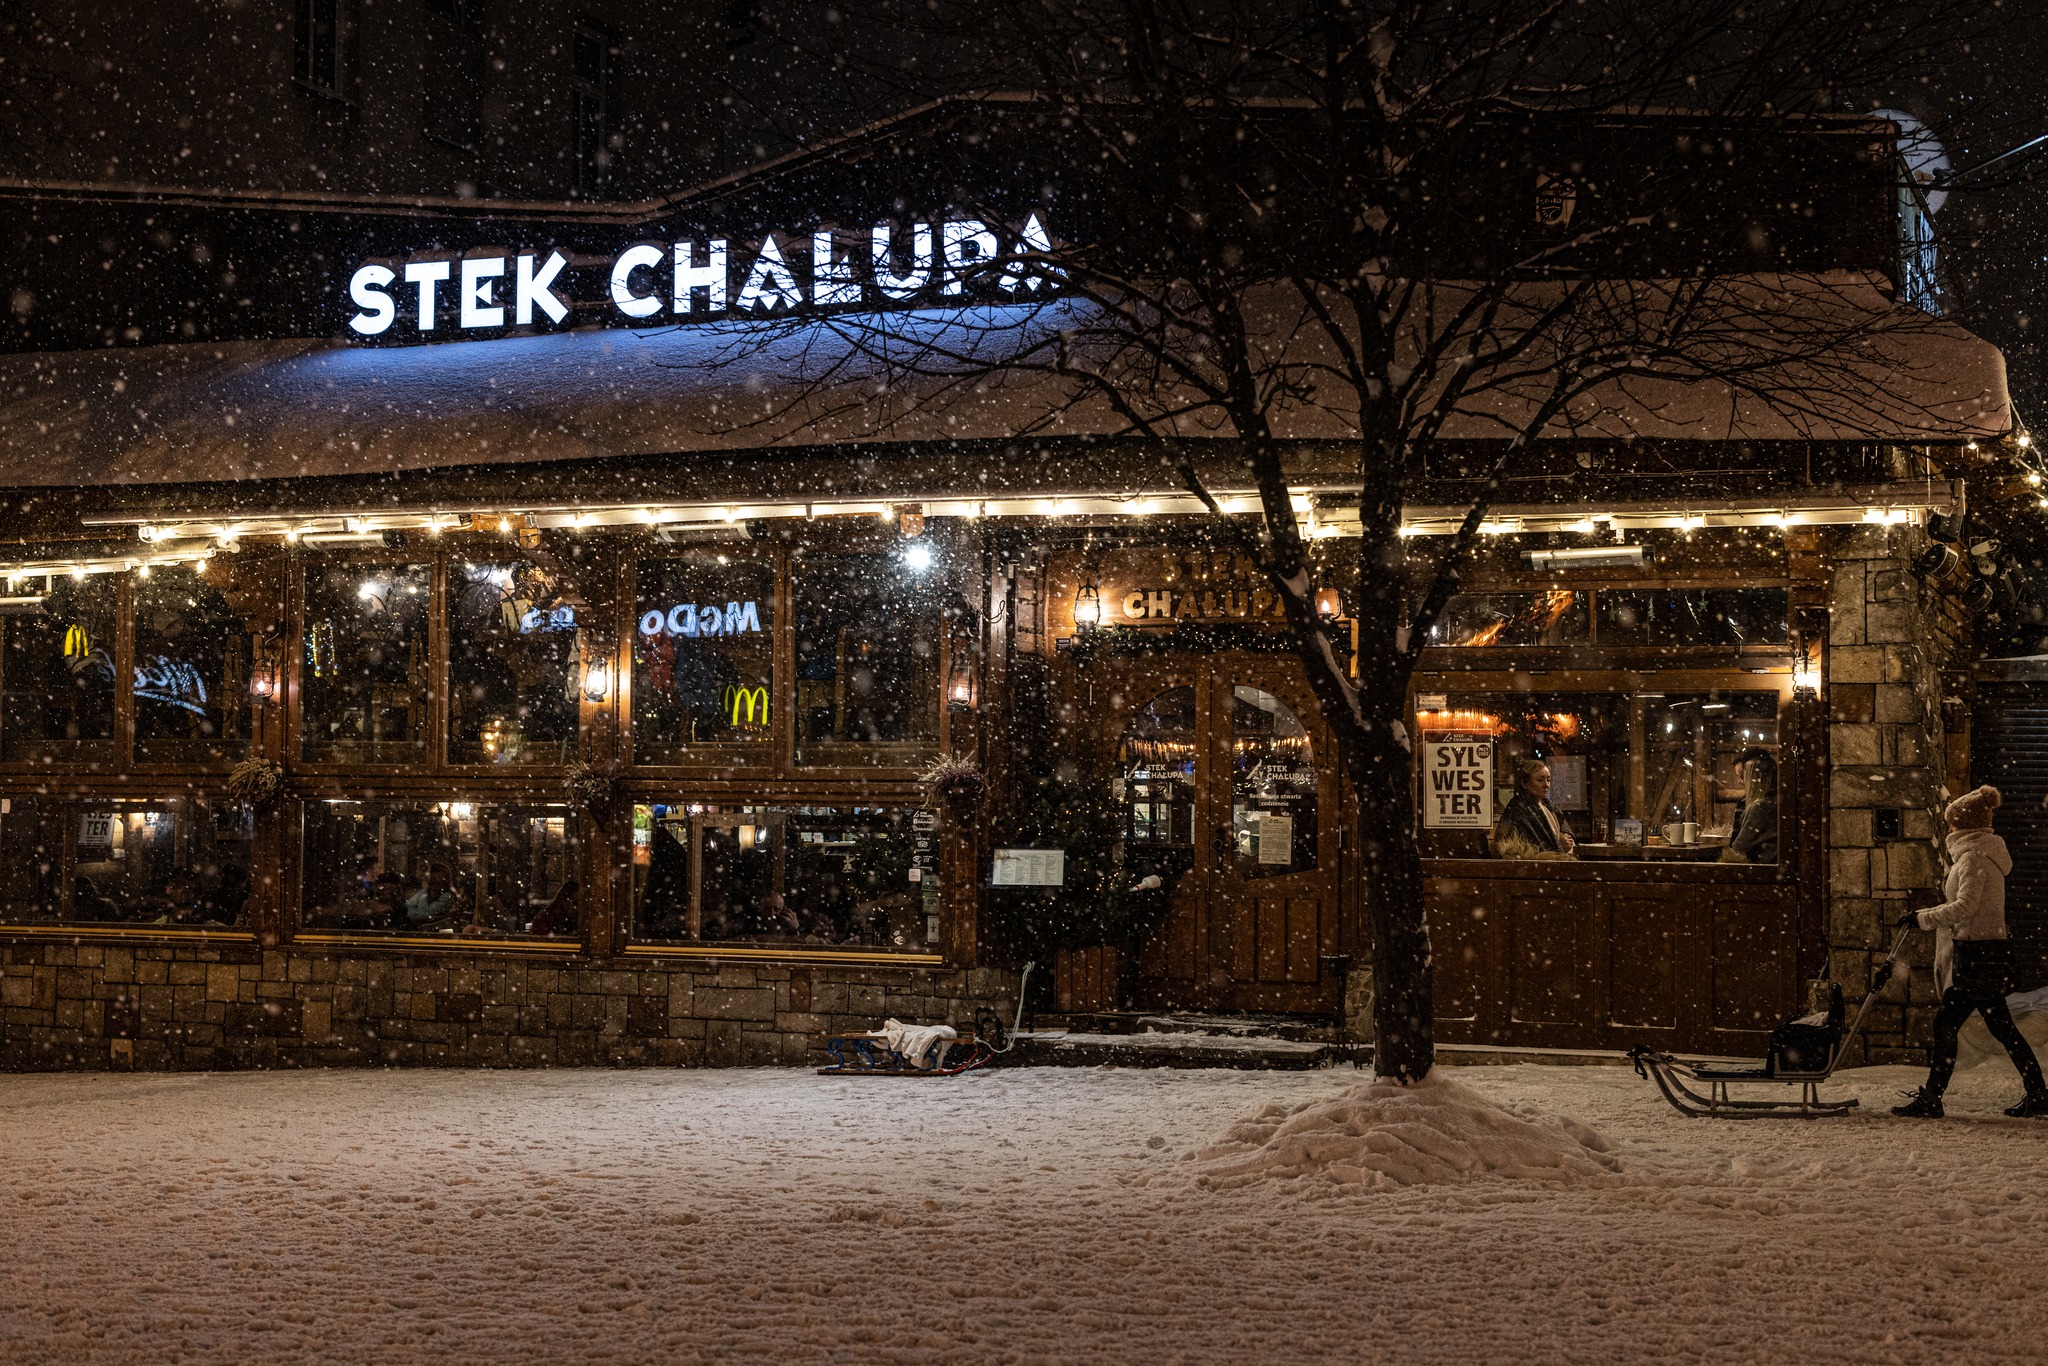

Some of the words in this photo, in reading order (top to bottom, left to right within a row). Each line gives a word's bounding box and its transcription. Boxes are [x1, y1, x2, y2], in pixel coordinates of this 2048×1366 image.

[349, 249, 569, 336] STEK
[1160, 552, 1257, 581] STEK
[1437, 746, 1480, 767] SYL
[1432, 770, 1485, 791] WES
[1436, 794, 1482, 815] TER
[86, 821, 109, 836] TER
